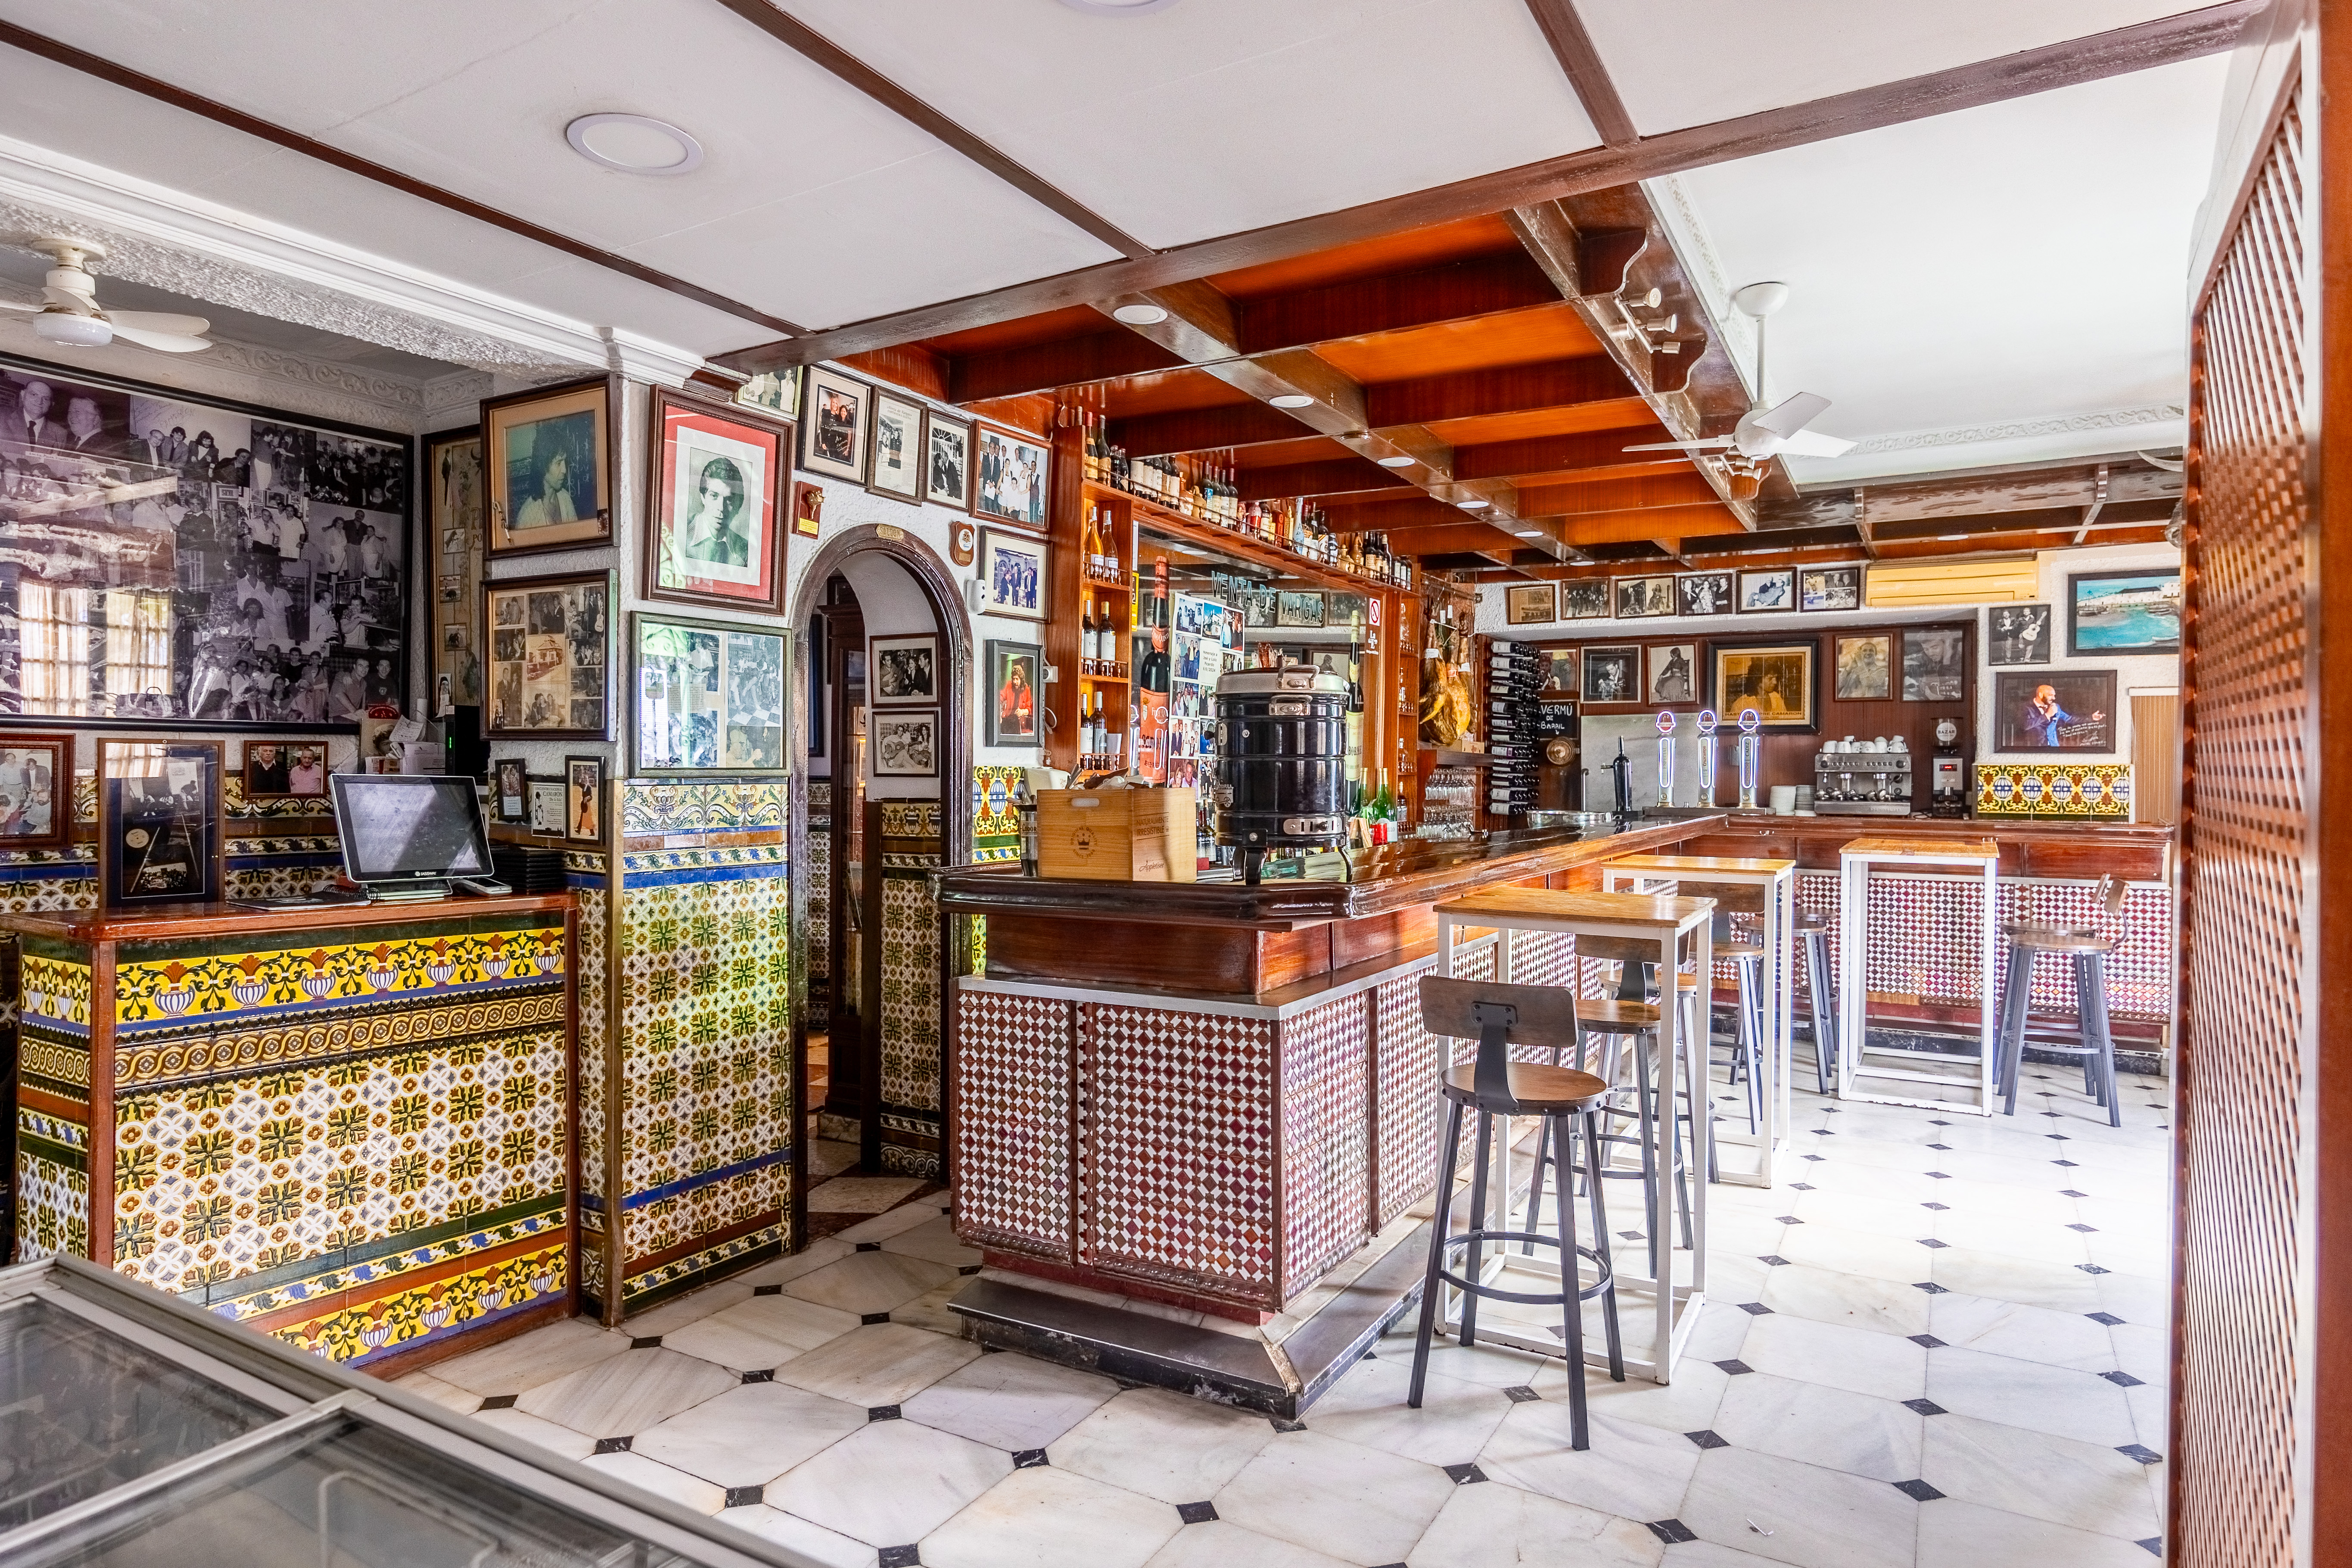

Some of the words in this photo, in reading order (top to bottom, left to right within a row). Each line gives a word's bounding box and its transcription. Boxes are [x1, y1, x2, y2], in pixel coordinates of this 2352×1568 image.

[1211, 570, 1253, 607] VENTA
[1259, 584, 1276, 613] DE
[1281, 590, 1325, 625] VARGAS
[1348, 745, 1362, 756] BORNE
[1136, 816, 1169, 826] NATURALMENTE
[1136, 825, 1164, 837] IRRESISTIBLE
[1139, 862, 1164, 872] Appletiser
